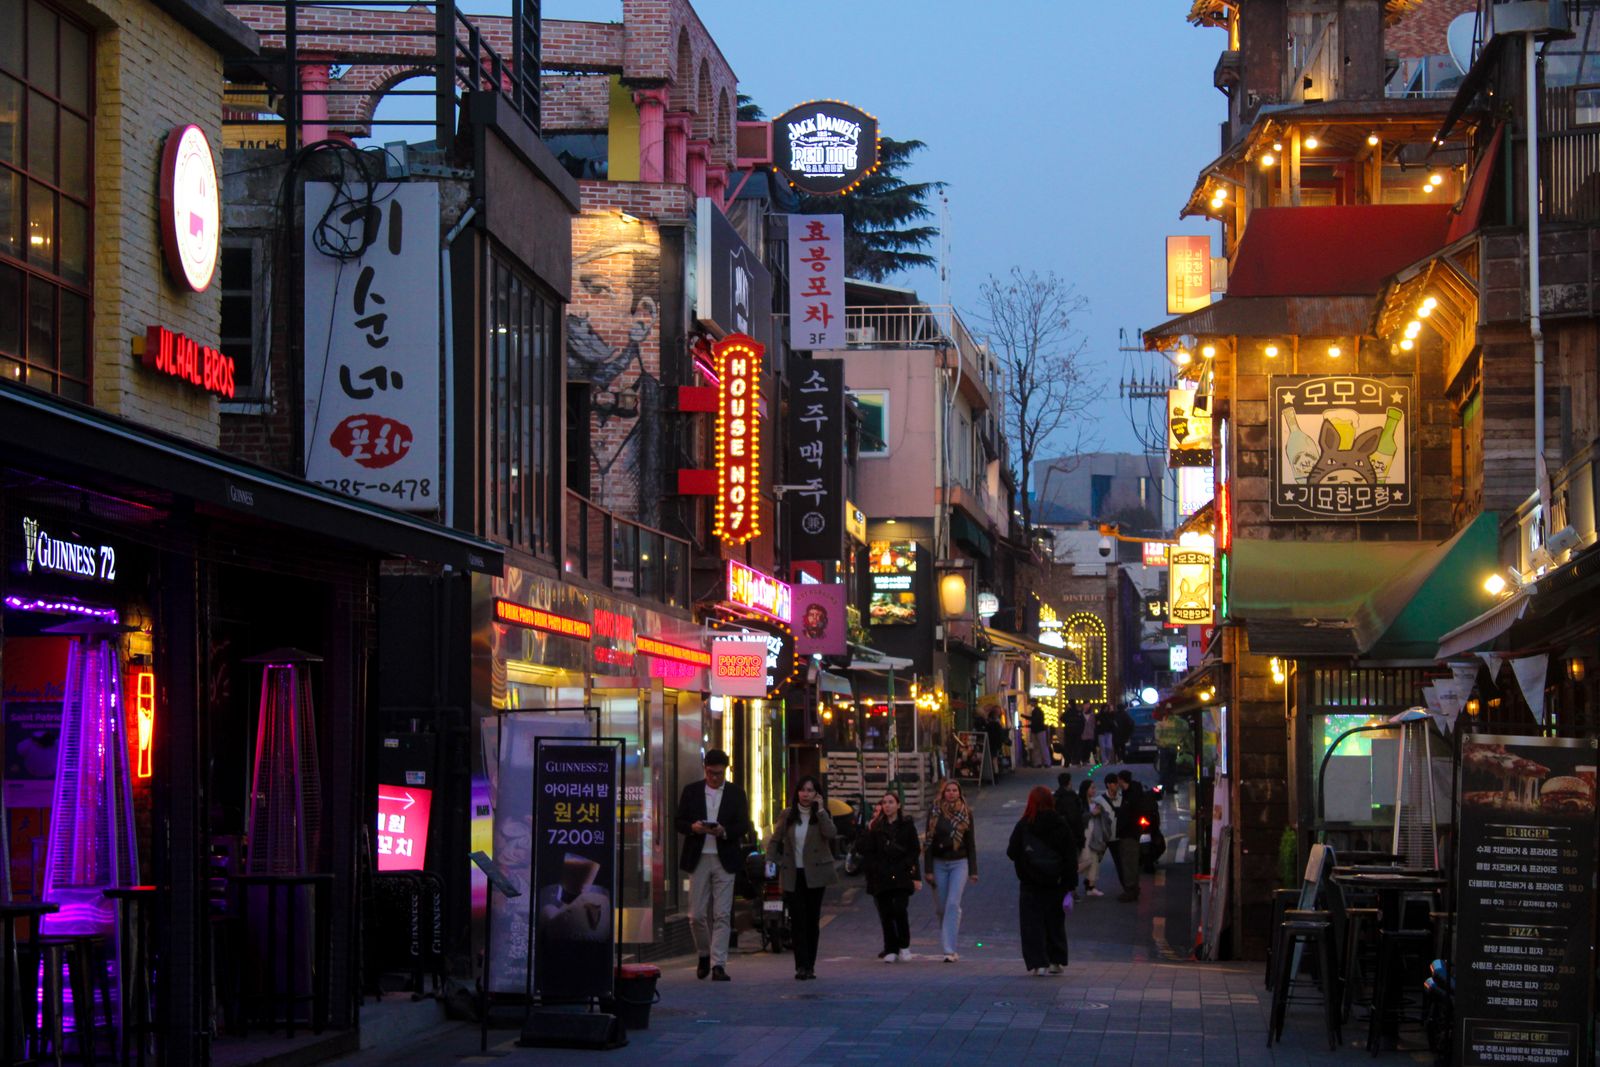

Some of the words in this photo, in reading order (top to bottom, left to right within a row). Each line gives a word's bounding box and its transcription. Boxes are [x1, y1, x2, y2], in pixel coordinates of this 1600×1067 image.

[788, 118, 817, 140] JACK
[817, 113, 861, 140] DANIEL'S
[799, 221, 834, 330] 효봉포차
[809, 334, 826, 345] 3F
[156, 327, 202, 386] JILHAL
[203, 346, 235, 400] BROS
[1304, 381, 1382, 406] 모모의
[730, 360, 746, 458] HOUSE
[347, 419, 412, 460] 포차
[799, 370, 829, 508] 소주맥주
[730, 467, 745, 530] NO.7
[37, 530, 96, 577] GUINNESS
[100, 545, 115, 581] 72
[1063, 594, 1108, 604] DISTRICT
[718, 656, 762, 666] PHOTO
[718, 666, 761, 676] DRINK
[545, 761, 598, 773] GUINNESS
[598, 761, 610, 773] 72
[544, 783, 594, 798] 아이리쉬
[596, 783, 609, 798] 밤
[553, 801, 573, 823] 원
[576, 801, 600, 823] 샷!
[547, 829, 605, 845] 7200원
[1505, 827, 1549, 839] BURGER
[1508, 927, 1541, 938] PIZZA
